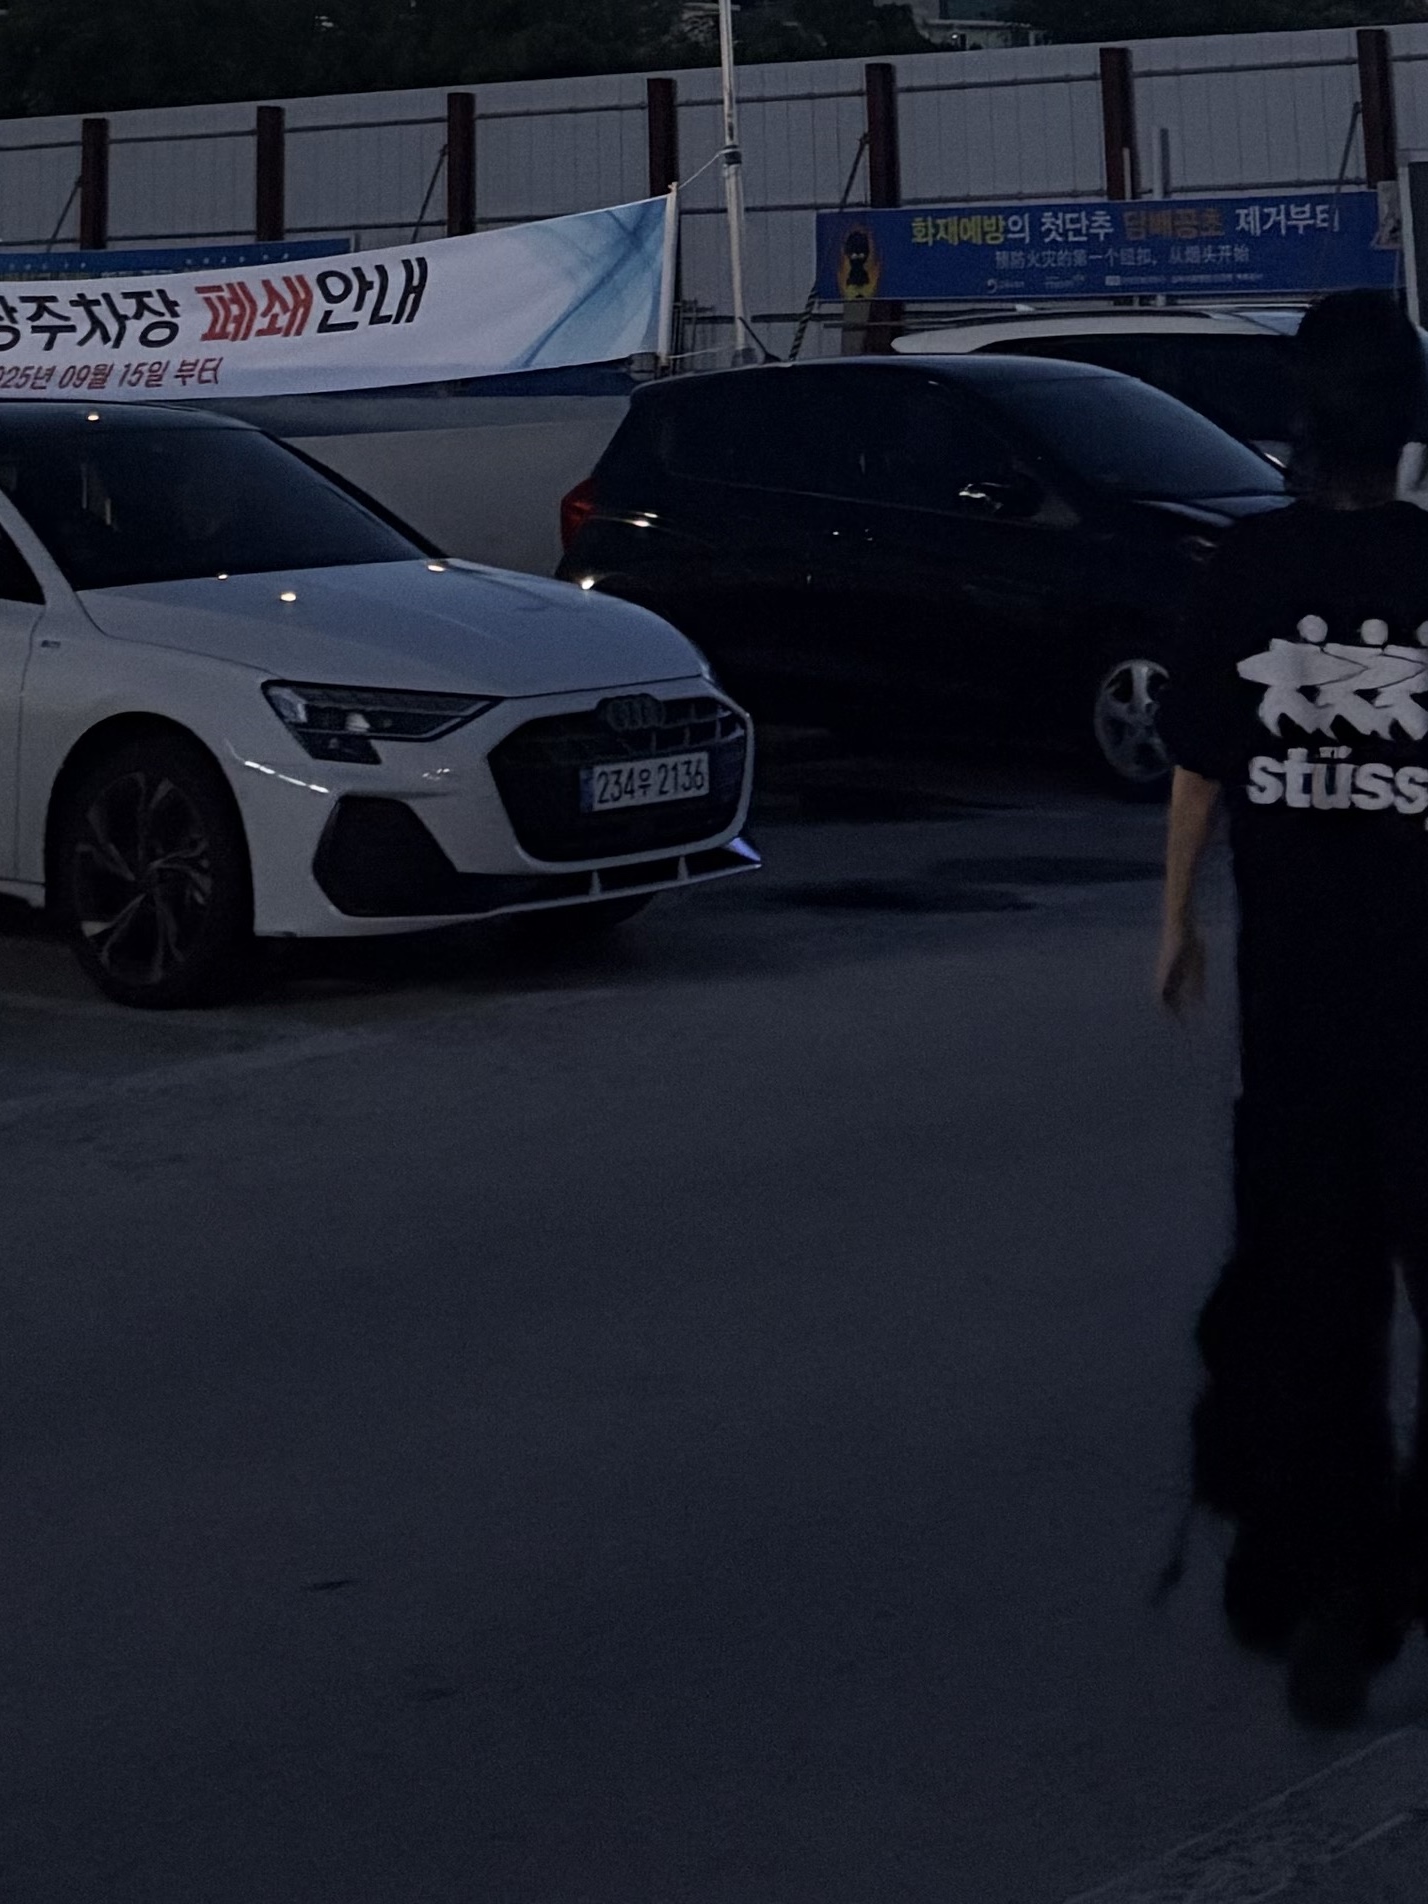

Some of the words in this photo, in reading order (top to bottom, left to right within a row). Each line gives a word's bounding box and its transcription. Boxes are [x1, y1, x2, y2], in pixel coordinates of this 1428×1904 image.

[911, 212, 1031, 247] 화재예방의
[1040, 210, 1115, 243] 첫단추
[1235, 202, 1340, 237] 제거부터
[58, 362, 114, 390] 09월
[117, 359, 170, 388] 15일
[174, 357, 224, 386] 부터
[597, 768, 652, 804] 234우
[658, 758, 704, 795] 2136
